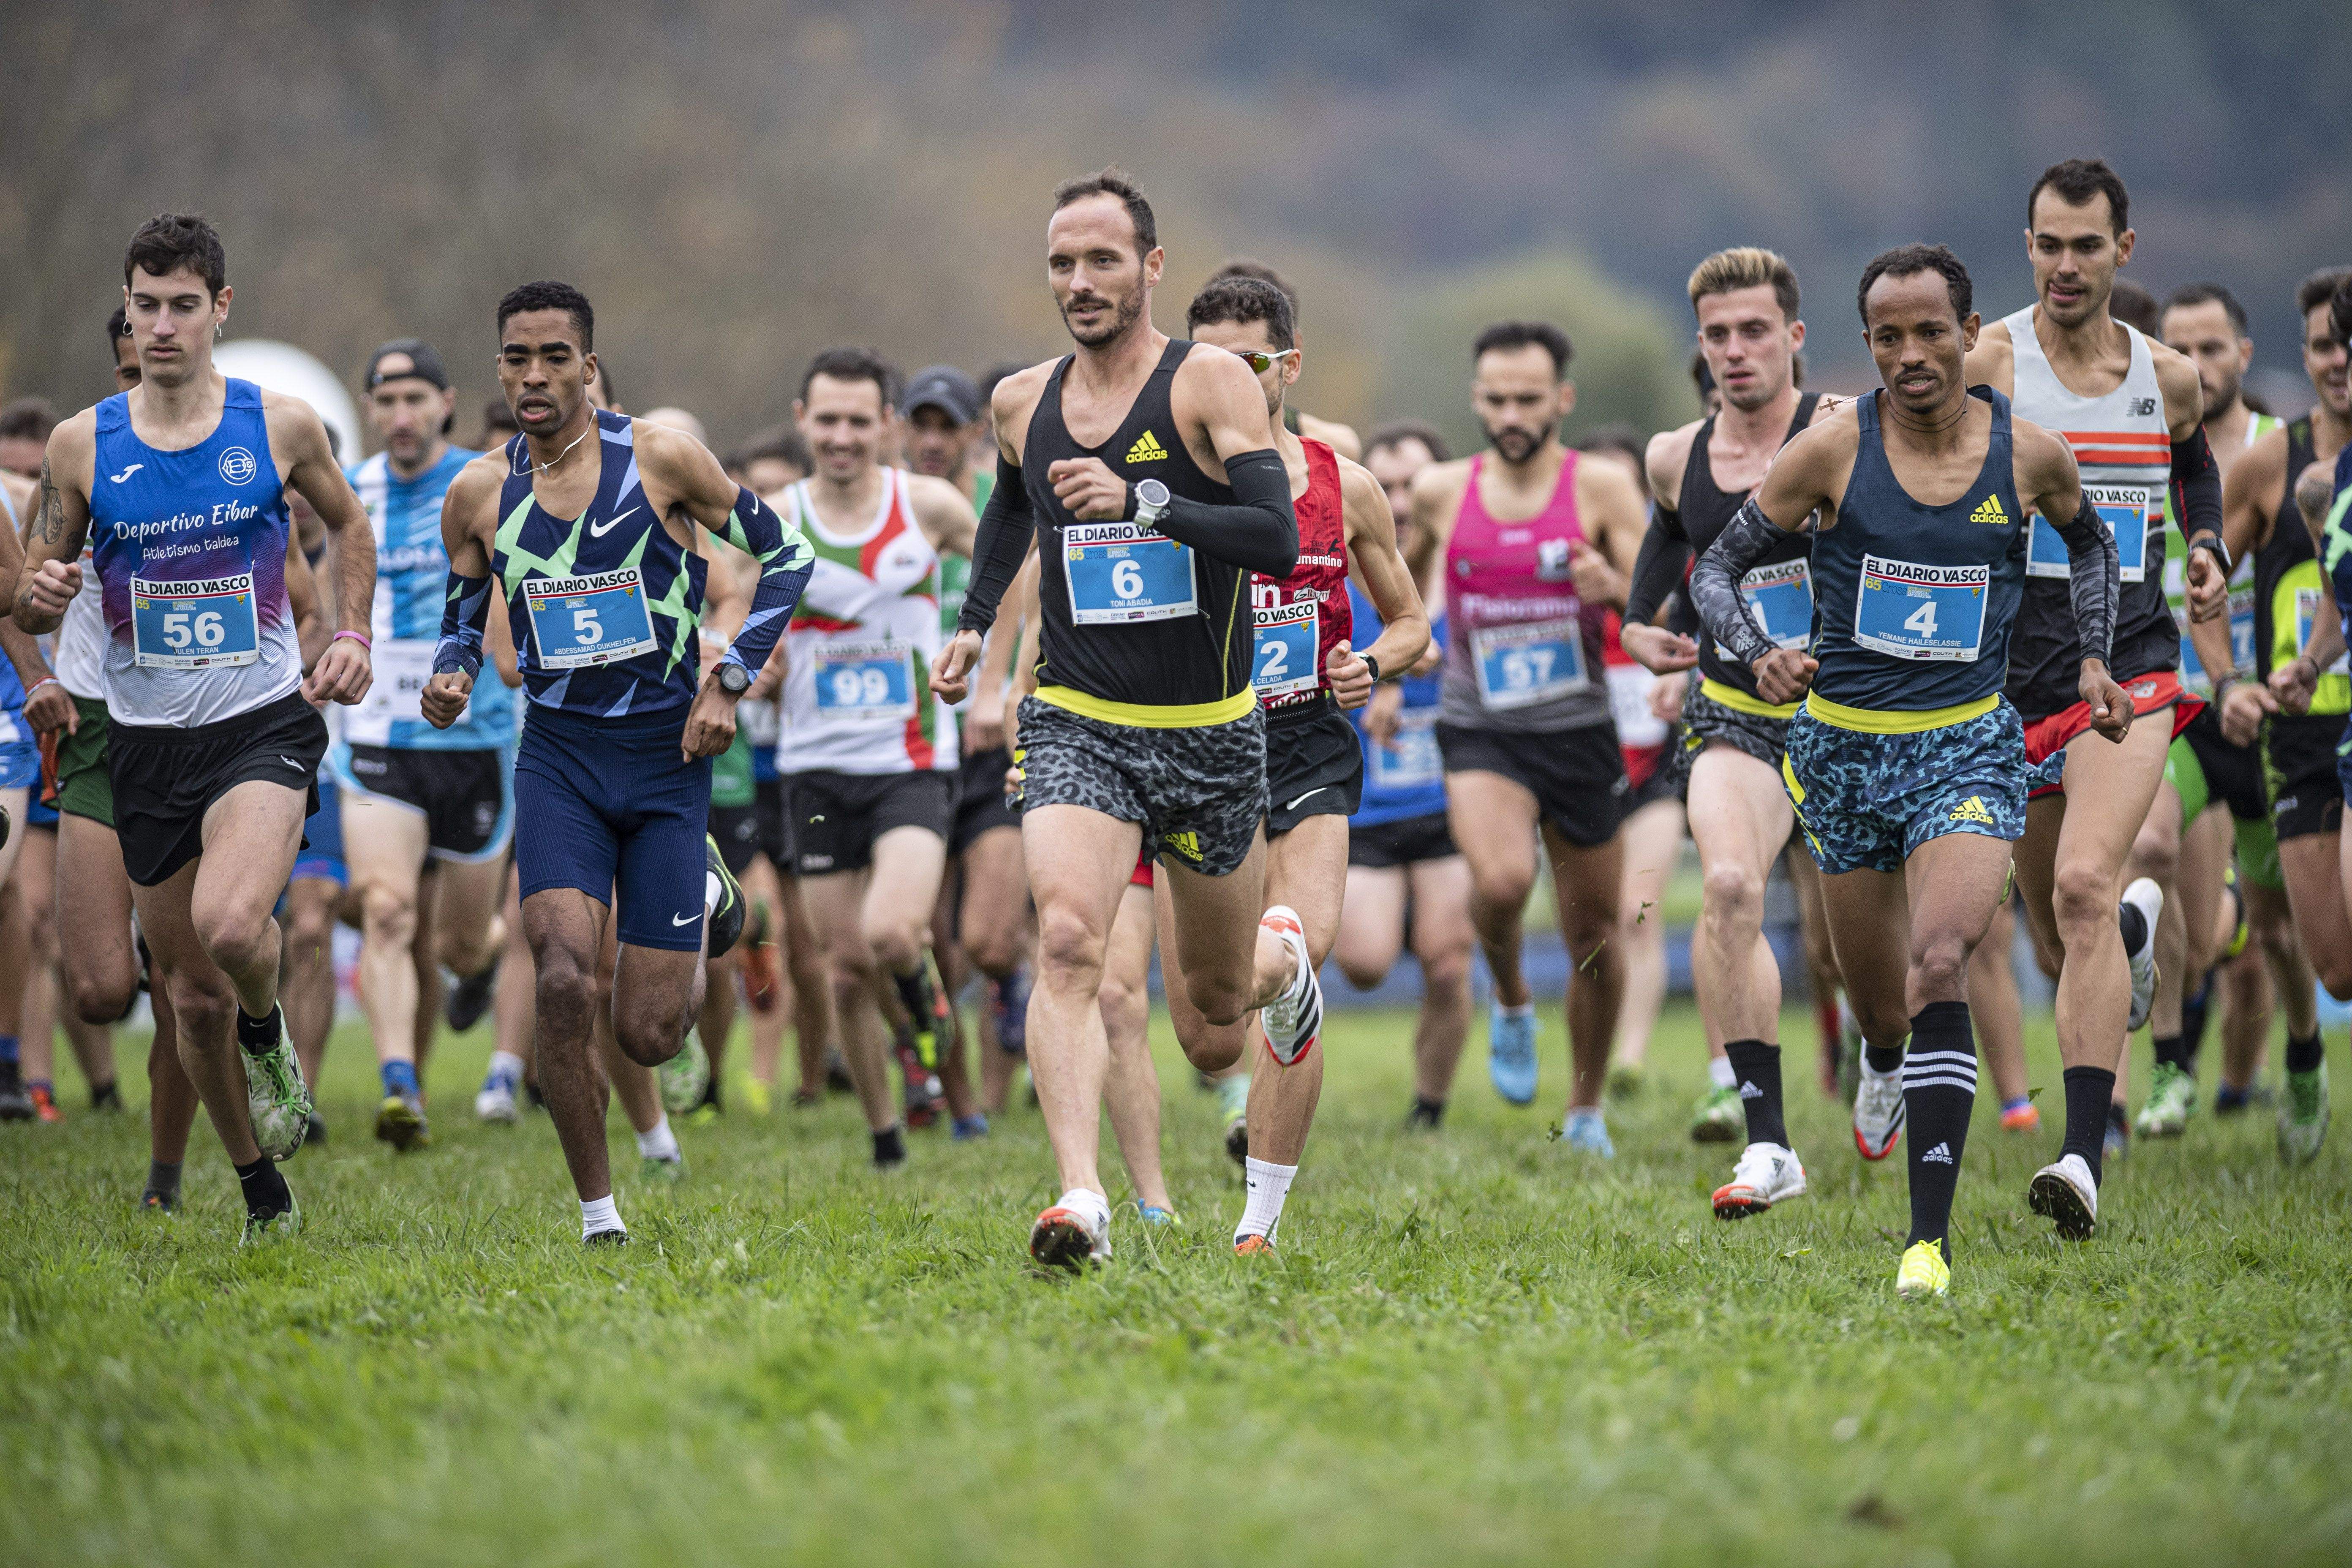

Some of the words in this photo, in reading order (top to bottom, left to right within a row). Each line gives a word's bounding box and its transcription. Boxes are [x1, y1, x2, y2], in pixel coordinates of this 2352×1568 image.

[1126, 448, 1168, 464] adidas
[2107, 489, 2146, 502] VASCO
[114, 513, 204, 544] Deportivo
[212, 499, 258, 525] Eibar
[1970, 511, 2009, 524] adidas
[1069, 529, 1083, 542] EL
[1085, 525, 1134, 541] DIARIO
[143, 544, 201, 561] Atletismo
[204, 535, 239, 551] taldea
[1069, 548, 1084, 561] 65
[1084, 548, 1107, 559] Cross
[1111, 560, 1143, 599] 6
[1759, 563, 1804, 581] VASCO
[1867, 559, 1883, 574] EL
[1886, 563, 1940, 582] DIARIO
[1944, 569, 1987, 582] VASCO
[135, 580, 148, 593] EL
[149, 582, 199, 595] DIARIO
[201, 576, 249, 593] VASCO
[527, 583, 542, 594] EL
[543, 579, 588, 593] DIARIO
[589, 570, 637, 588] VASCO
[1865, 577, 1881, 591] 65
[1882, 581, 1907, 595] Cross
[136, 598, 150, 610] 65
[150, 600, 172, 611] Cross
[532, 600, 546, 611] 65
[545, 600, 566, 610] Cross
[1127, 598, 1153, 606] ABADIA
[1271, 604, 1314, 622] VASCO
[1904, 602, 1938, 638] 4
[163, 611, 225, 648] 56
[574, 609, 603, 645] 5
[555, 645, 596, 655] ABDESSAMAD
[597, 637, 637, 650] OUKHELFEN
[1878, 631, 1907, 643] YEMANE
[1908, 638, 1962, 646] HAILESELASSIE
[1260, 641, 1288, 677] 2
[833, 668, 889, 705] 99
[1257, 675, 1282, 684] CELADA
[1949, 810, 1993, 824] adidas
[1166, 835, 1203, 861] adidas
[1922, 1154, 1953, 1164] adidas
